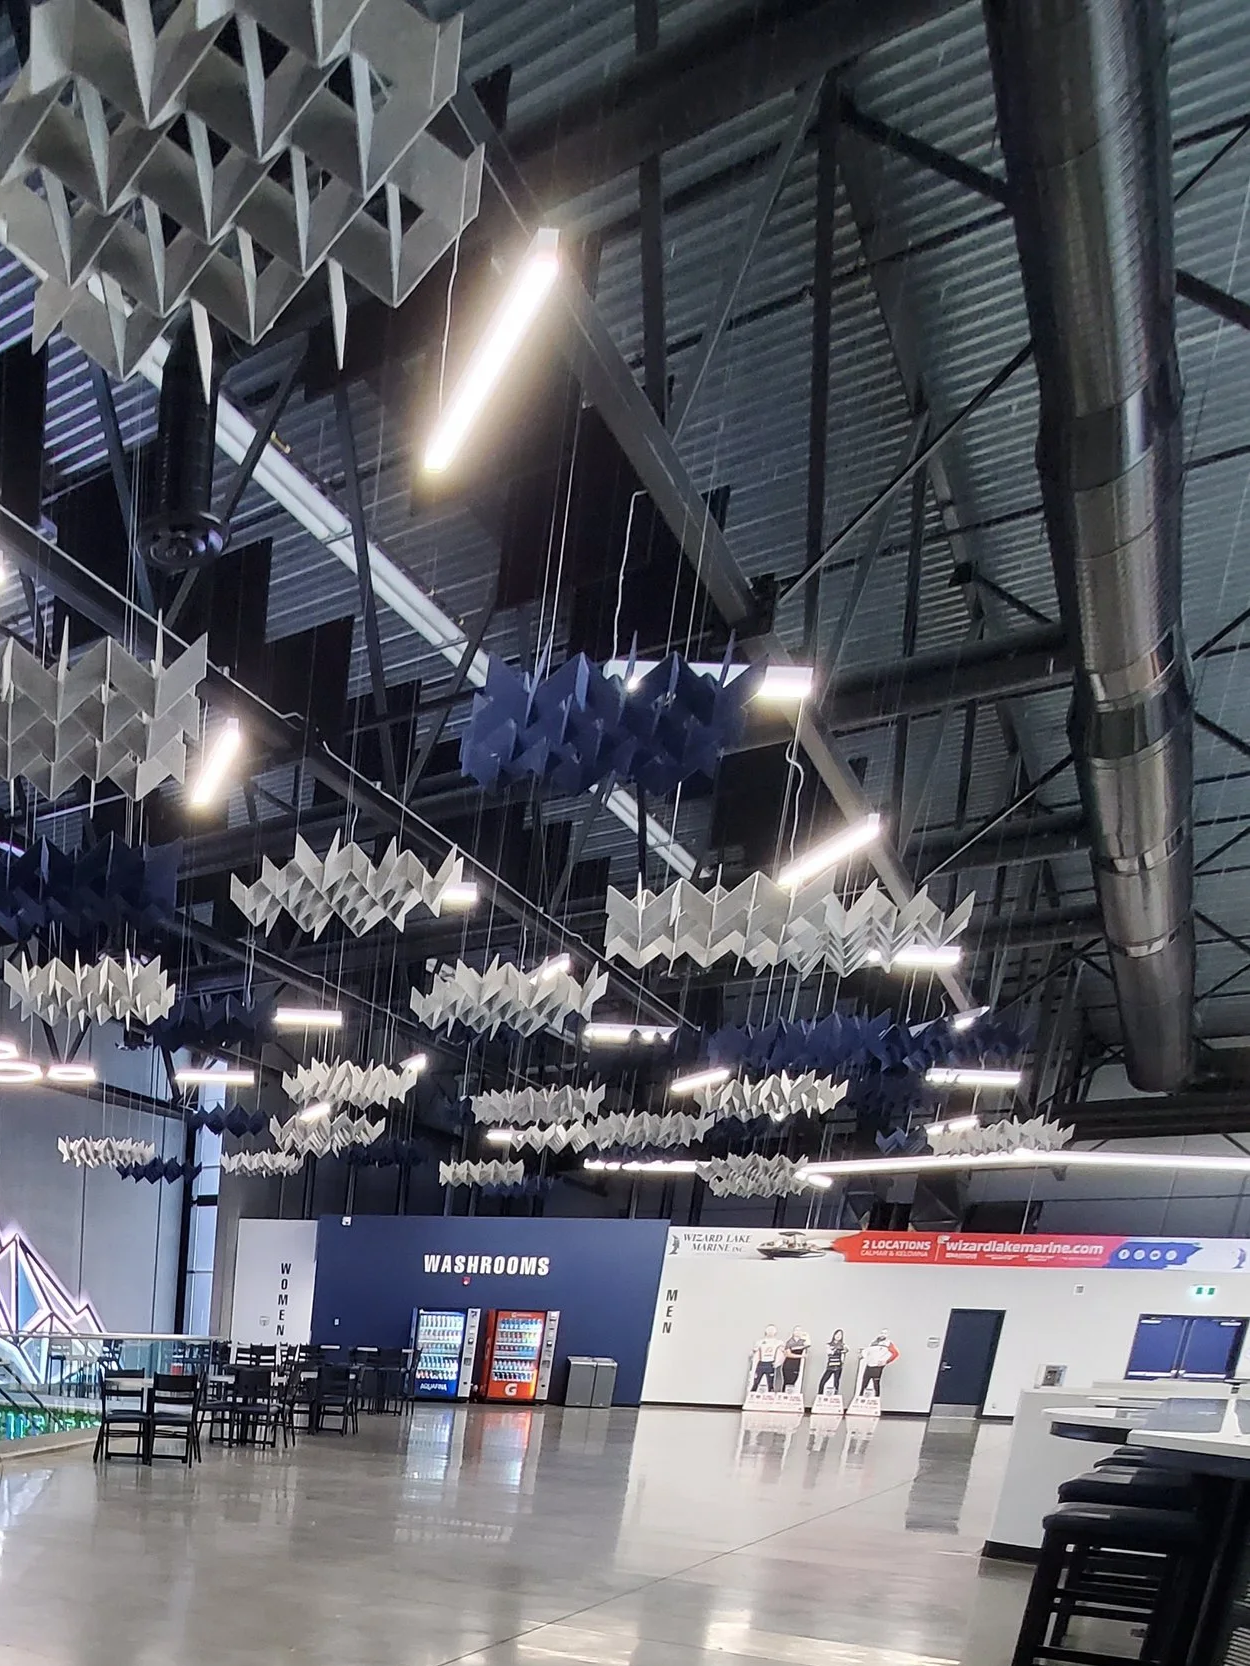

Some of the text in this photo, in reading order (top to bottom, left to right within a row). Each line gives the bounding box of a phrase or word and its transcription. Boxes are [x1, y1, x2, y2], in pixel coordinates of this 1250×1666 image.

[683, 1233, 753, 1243] WIZARD LAKE
[692, 1243, 730, 1252] MARINE
[862, 1239, 931, 1251] 2 LOCATIONS
[945, 1239, 1104, 1255] wizardlakemarine.com
[423, 1254, 551, 1276] WASHROOMS
[276, 1262, 292, 1336] WOMEN
[662, 1289, 679, 1334] MEN
[419, 1382, 448, 1392] AQUAFINA
[504, 1383, 518, 1396] G
